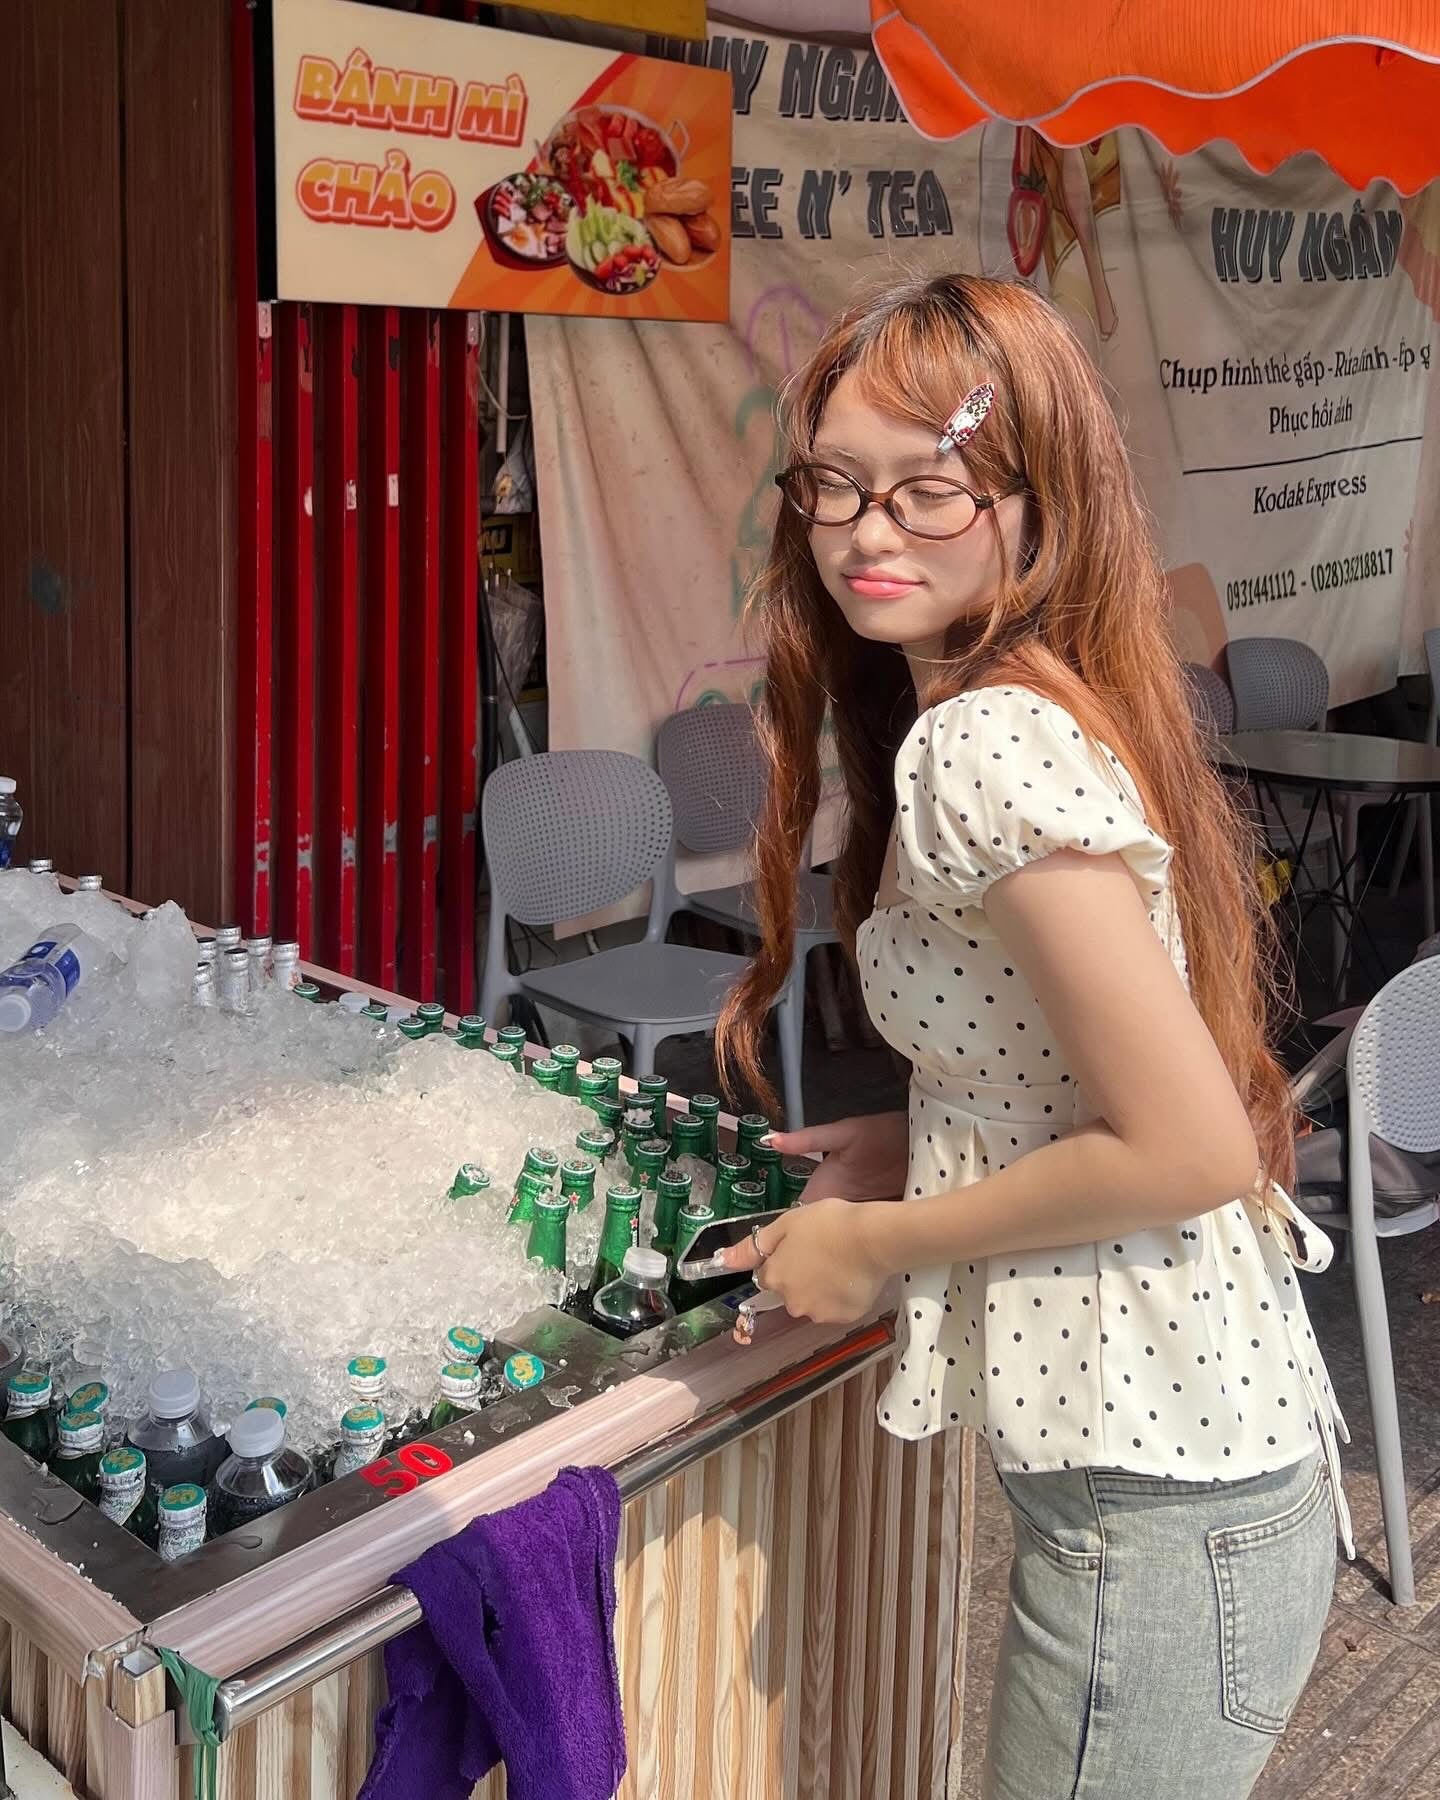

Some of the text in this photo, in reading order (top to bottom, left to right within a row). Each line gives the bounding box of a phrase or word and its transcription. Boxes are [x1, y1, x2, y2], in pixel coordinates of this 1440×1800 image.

[295, 48, 528, 147] BÁNH MÌ
[296, 149, 457, 232] CHẢO
[866, 170, 953, 238] TEA
[1211, 198, 1403, 283] HUY NGÂN
[1160, 358, 1217, 394] Chụp
[1221, 357, 1263, 386] hình
[1293, 351, 1325, 388] gấp
[1269, 406, 1308, 437] Phục
[1253, 475, 1367, 514] Kodak Express
[1226, 569, 1297, 611] 0931441112
[359, 1442, 454, 1497] 50
